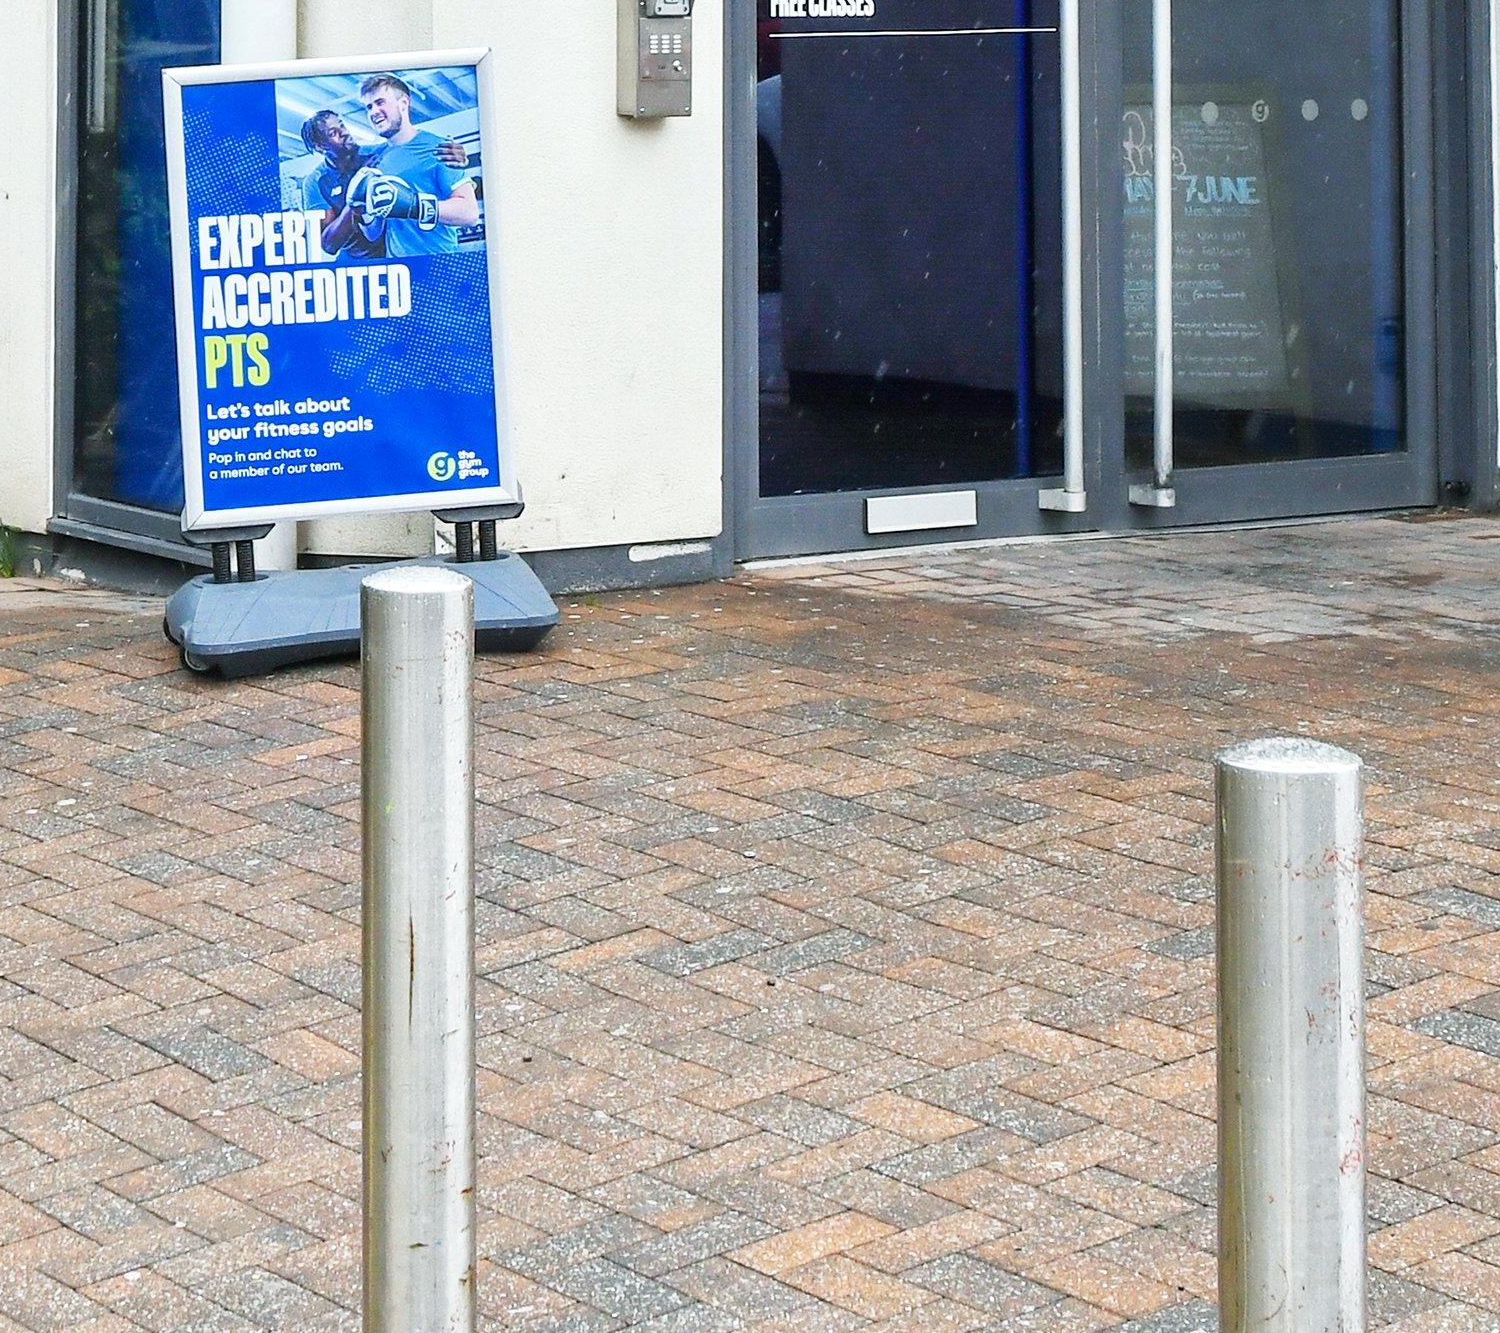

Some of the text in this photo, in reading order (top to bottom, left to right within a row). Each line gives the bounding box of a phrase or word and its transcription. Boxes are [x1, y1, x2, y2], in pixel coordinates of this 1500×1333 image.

[1198, 175, 1260, 205] JUNE
[197, 209, 326, 270] EXPERT
[201, 264, 412, 330] ACCREDITED
[203, 332, 270, 389] PTS
[206, 397, 350, 420] Let's talk about
[207, 415, 373, 446] your fitness goals
[209, 447, 317, 465] Pop in and chat to
[209, 461, 344, 480] a member of our team.
